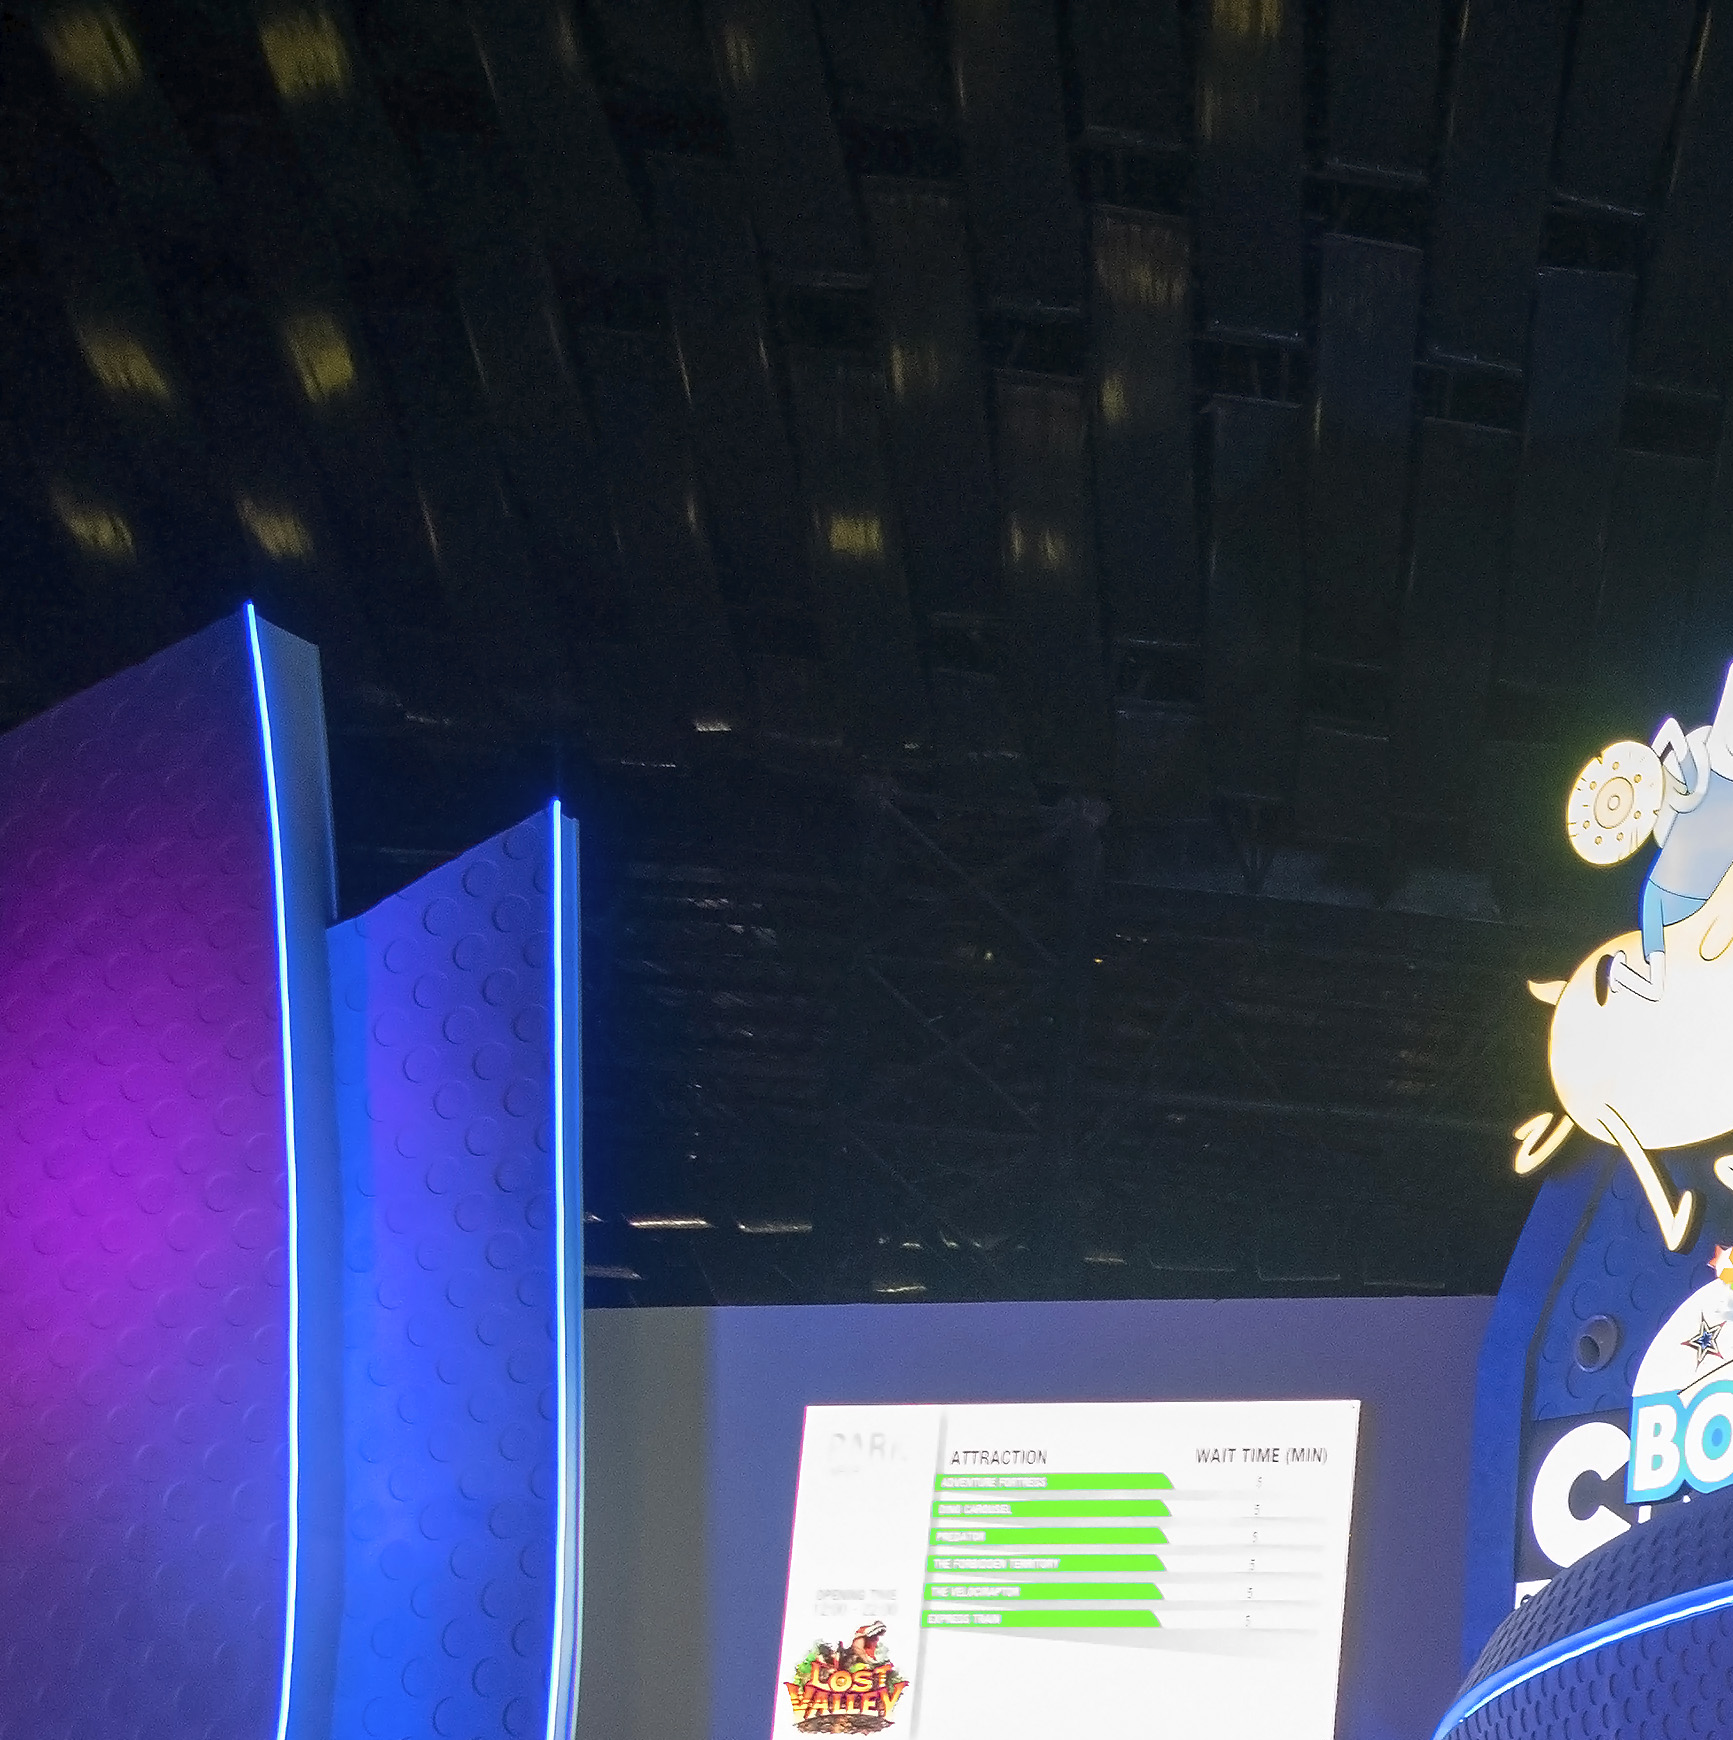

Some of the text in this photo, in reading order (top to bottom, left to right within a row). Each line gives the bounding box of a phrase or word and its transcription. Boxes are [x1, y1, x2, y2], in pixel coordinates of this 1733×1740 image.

[951, 1450, 1047, 1465] ATTRACTION
[1196, 1447, 1328, 1465] WAIT TIME (MIN)
[811, 1663, 894, 1692] LOST
[784, 1680, 909, 1721] VALLEY
